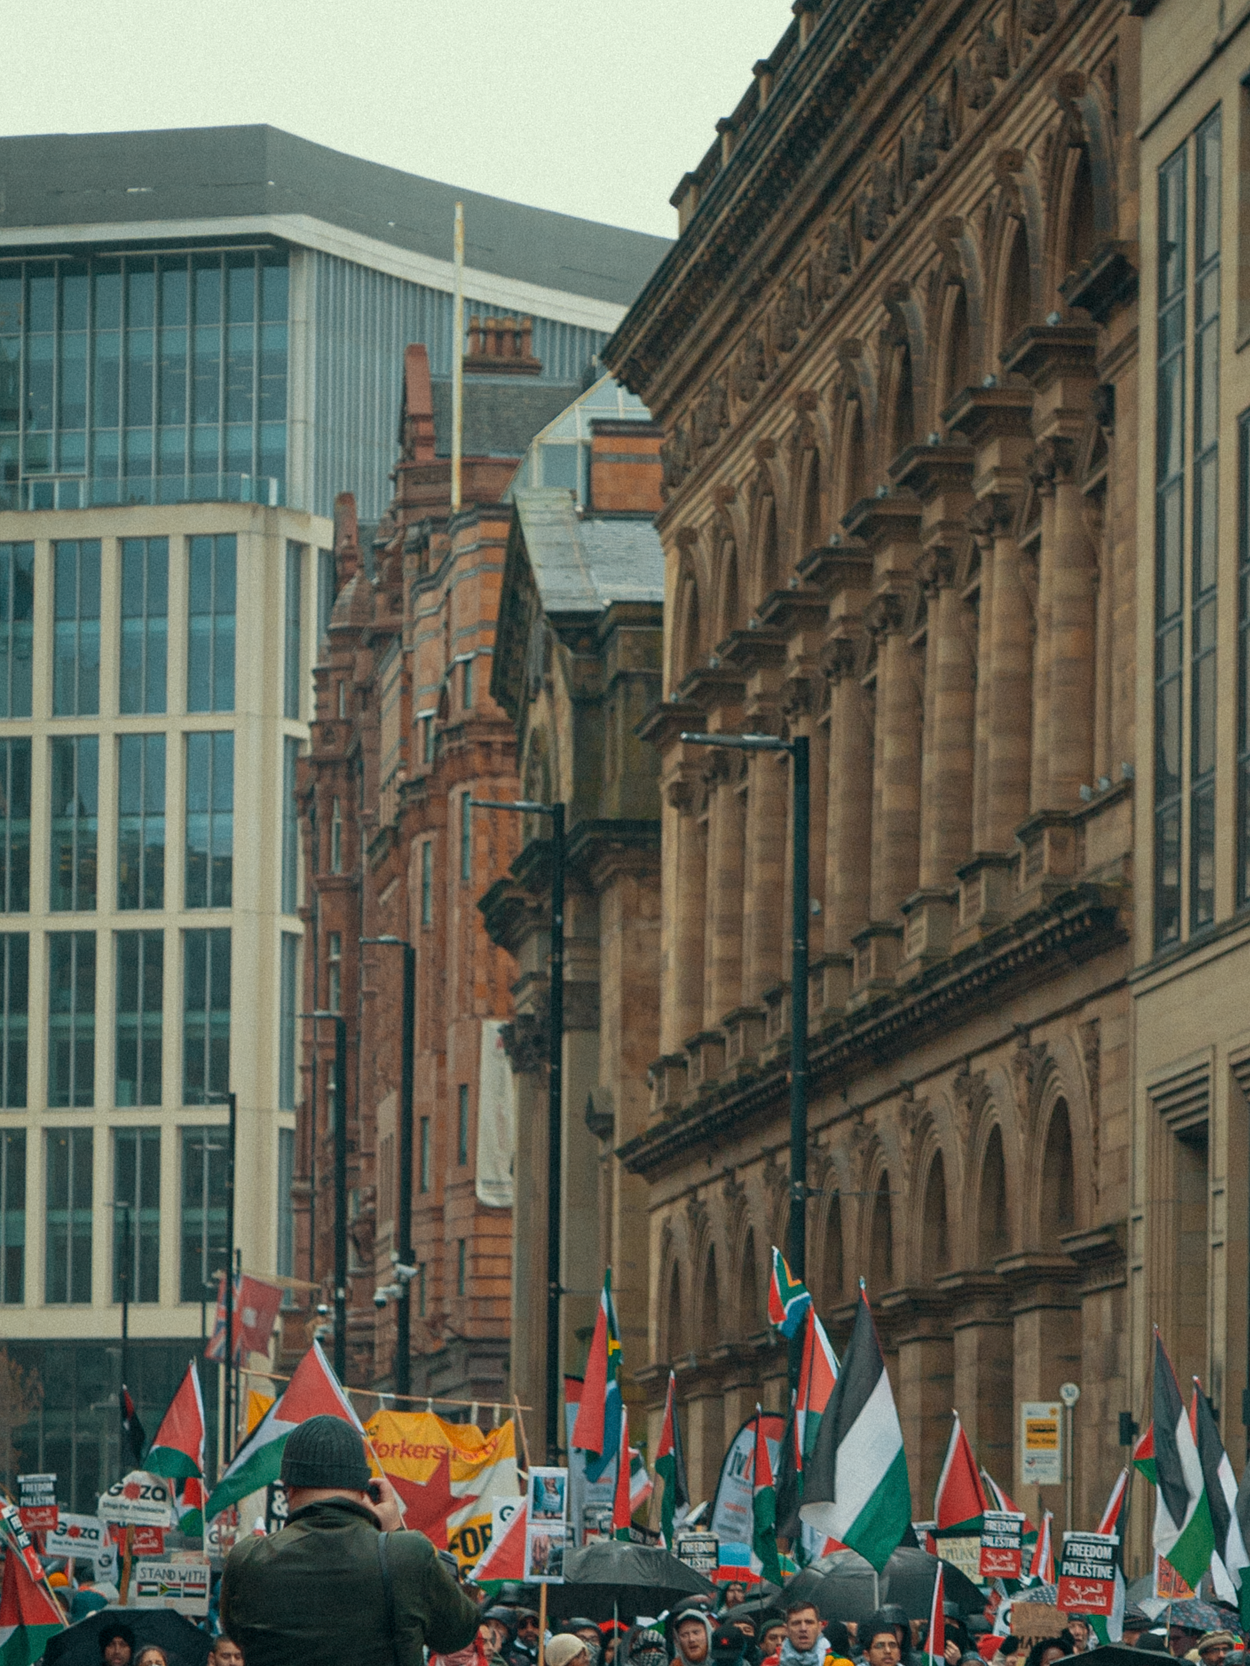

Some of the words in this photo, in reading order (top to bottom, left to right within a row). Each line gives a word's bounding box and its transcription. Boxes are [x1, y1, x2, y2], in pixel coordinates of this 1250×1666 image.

[107, 1482, 167, 1503] Gza
[55, 1521, 100, 1542] Gza
[984, 1520, 1021, 1533] FREEDOM
[981, 1534, 1021, 1549] PALESTINE
[1066, 1542, 1112, 1560] FREEDOM
[141, 1567, 175, 1580] STAND
[179, 1570, 206, 1583] WITH
[1062, 1562, 1113, 1580] PALESTINE
